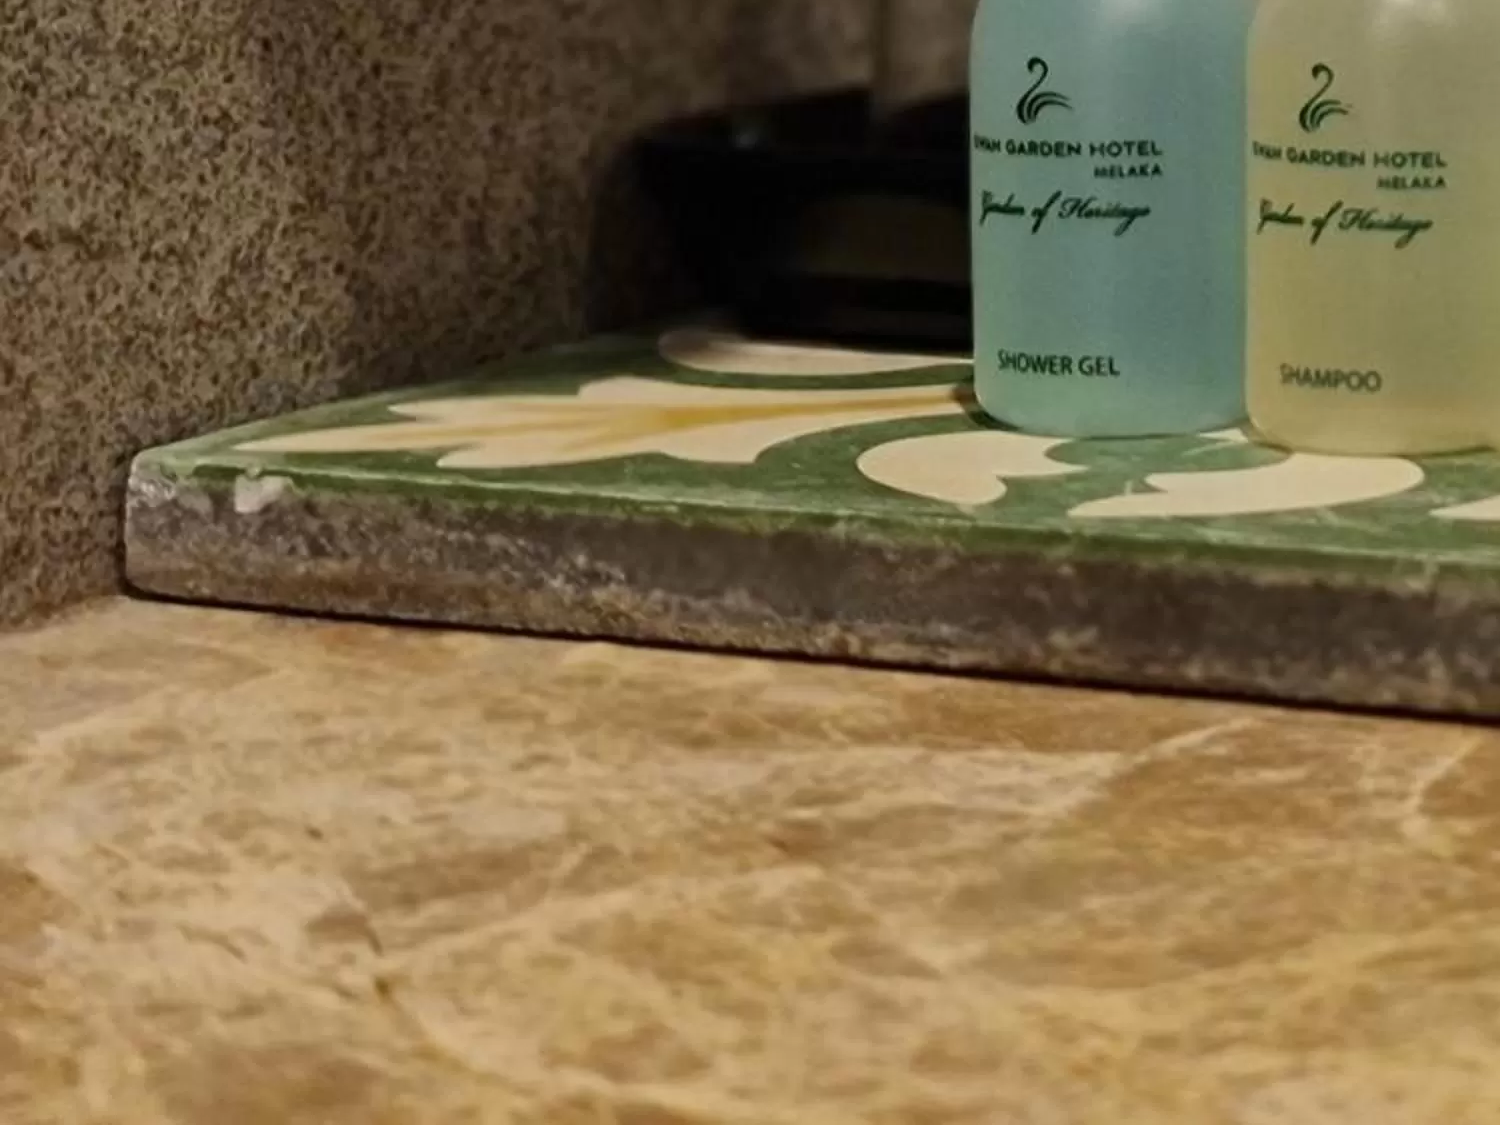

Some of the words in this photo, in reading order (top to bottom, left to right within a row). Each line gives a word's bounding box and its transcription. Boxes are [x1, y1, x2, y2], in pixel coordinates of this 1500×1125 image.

[1005, 139, 1081, 158] GARDEN
[1089, 140, 1163, 157] HOTEL
[1286, 147, 1366, 167] GARDEN
[1374, 152, 1448, 168] HOTEL
[1094, 163, 1163, 179] MELAKA
[1376, 175, 1447, 190] MELAKA
[1031, 189, 1063, 235] of
[1310, 199, 1344, 246] of
[997, 348, 1073, 376] SHOWER
[1078, 354, 1121, 377] GEL
[1279, 361, 1383, 394] SHAMPOO
